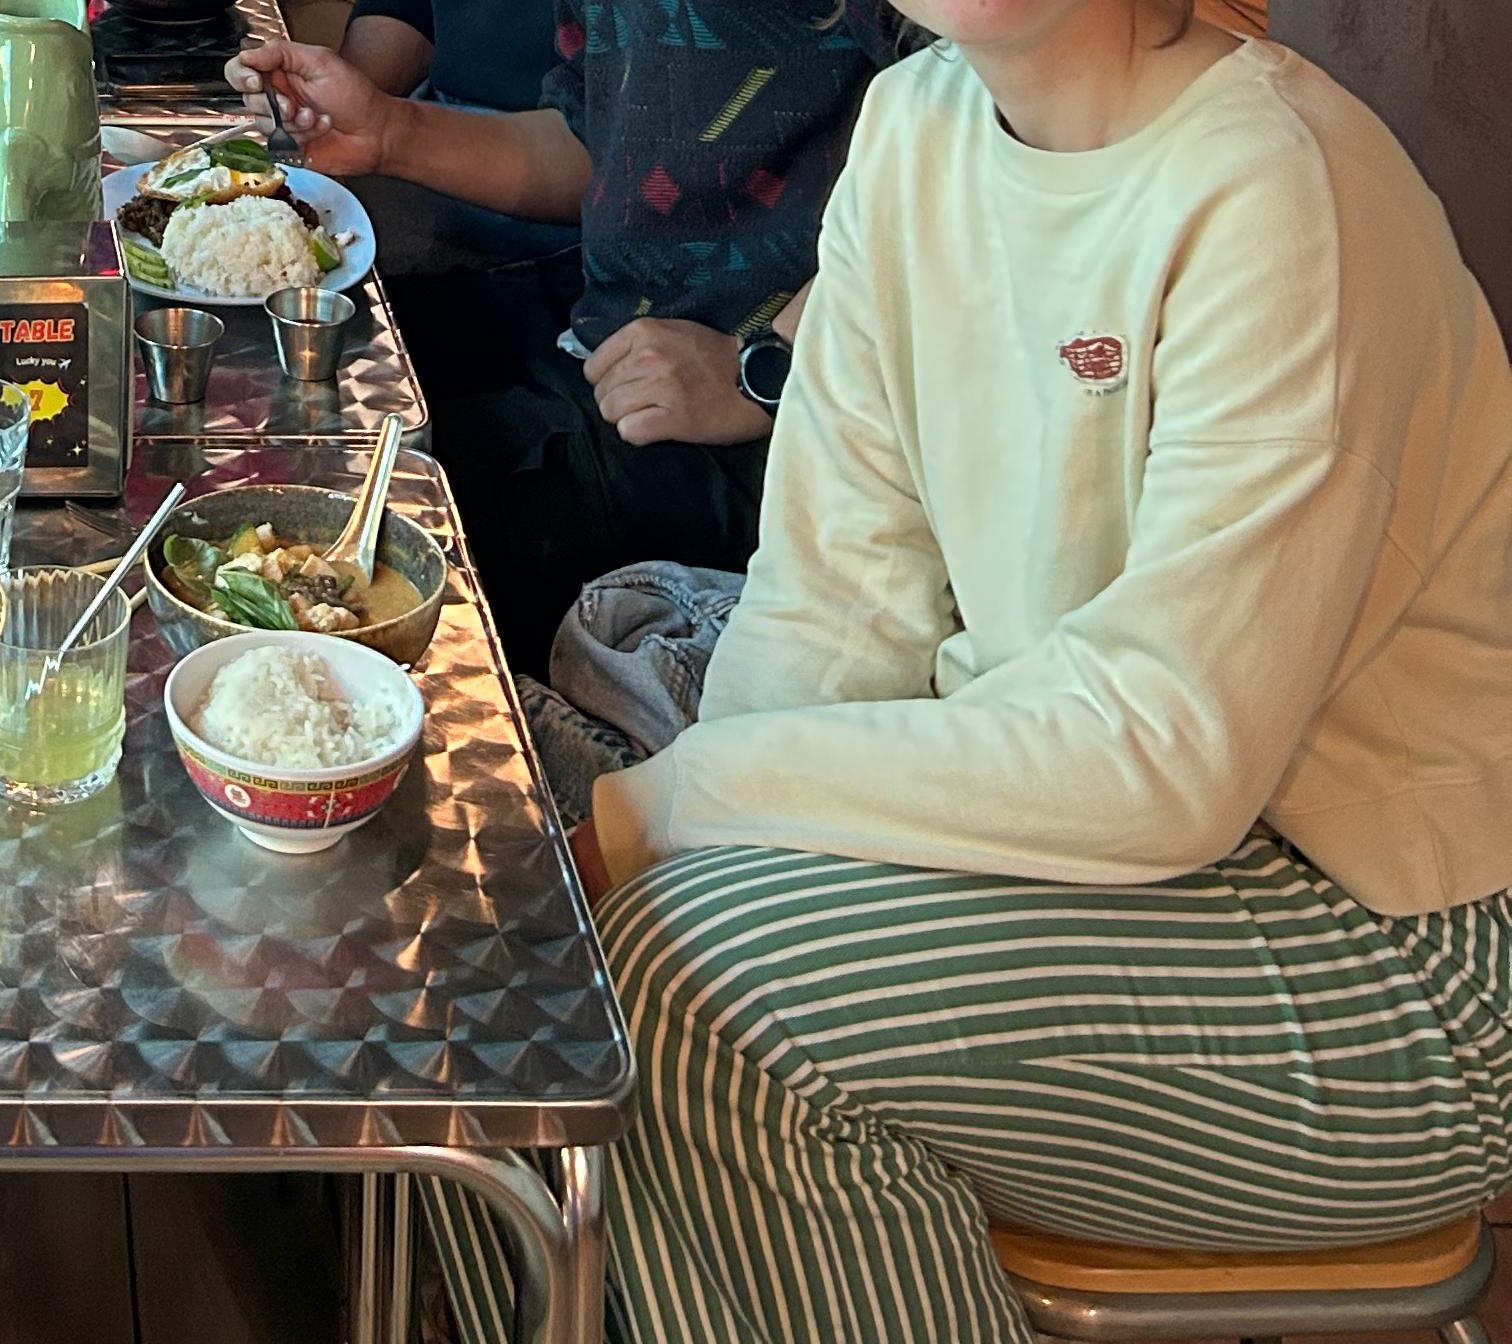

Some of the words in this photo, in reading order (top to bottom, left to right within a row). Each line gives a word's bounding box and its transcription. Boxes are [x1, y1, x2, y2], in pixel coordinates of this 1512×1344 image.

[0, 319, 75, 343] TABLE
[16, 356, 40, 366] Lucky
[41, 358, 57, 366] you
